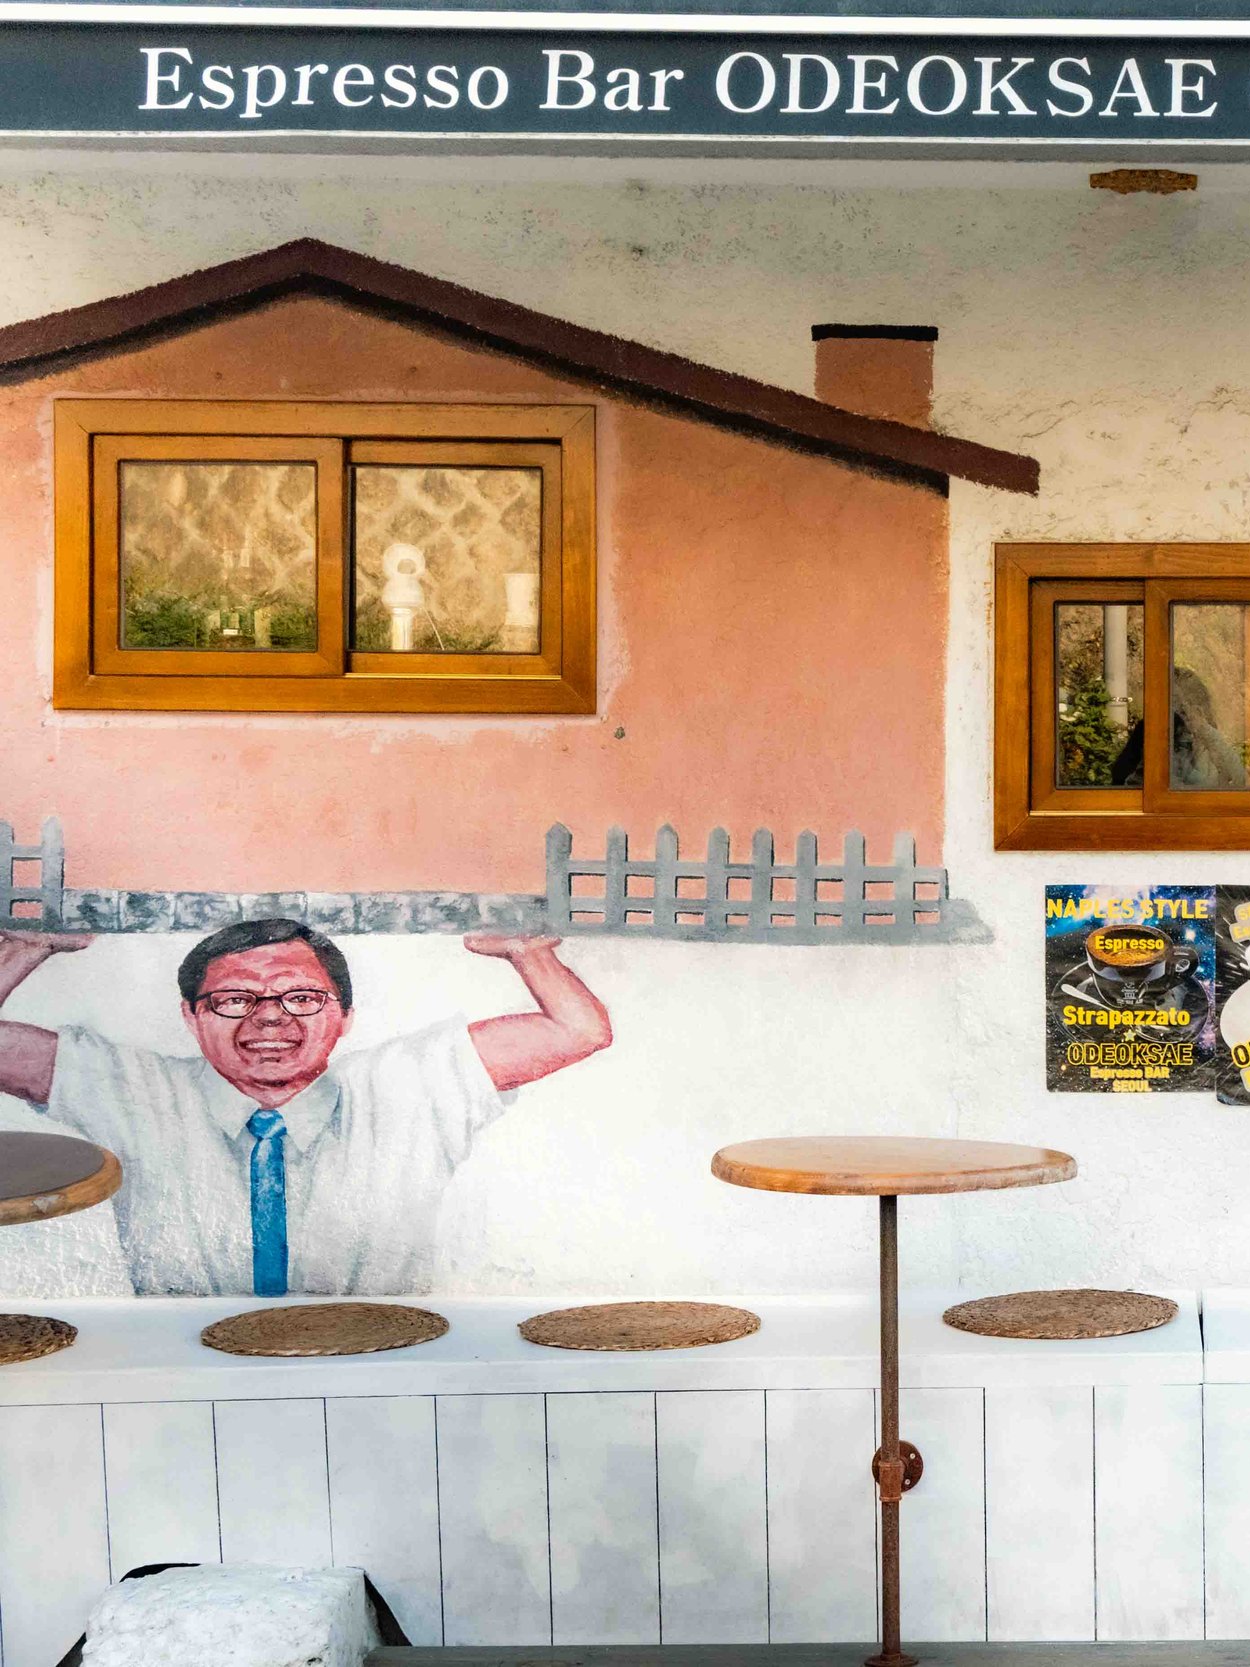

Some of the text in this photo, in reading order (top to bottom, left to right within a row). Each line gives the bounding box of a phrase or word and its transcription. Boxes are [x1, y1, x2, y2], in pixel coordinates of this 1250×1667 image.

[139, 46, 510, 119] Espresso
[539, 48, 685, 113] Bar
[715, 51, 1218, 117] ODEOKSAE
[1047, 898, 1209, 919] NAPLES STYLE
[1095, 935, 1164, 953] Espresso
[1063, 1005, 1190, 1029] Strapazzato
[1067, 1043, 1193, 1065] ODEOKSAE
[1090, 1066, 1170, 1080] Espresso BAR
[1112, 1080, 1152, 1092] SEOUL
